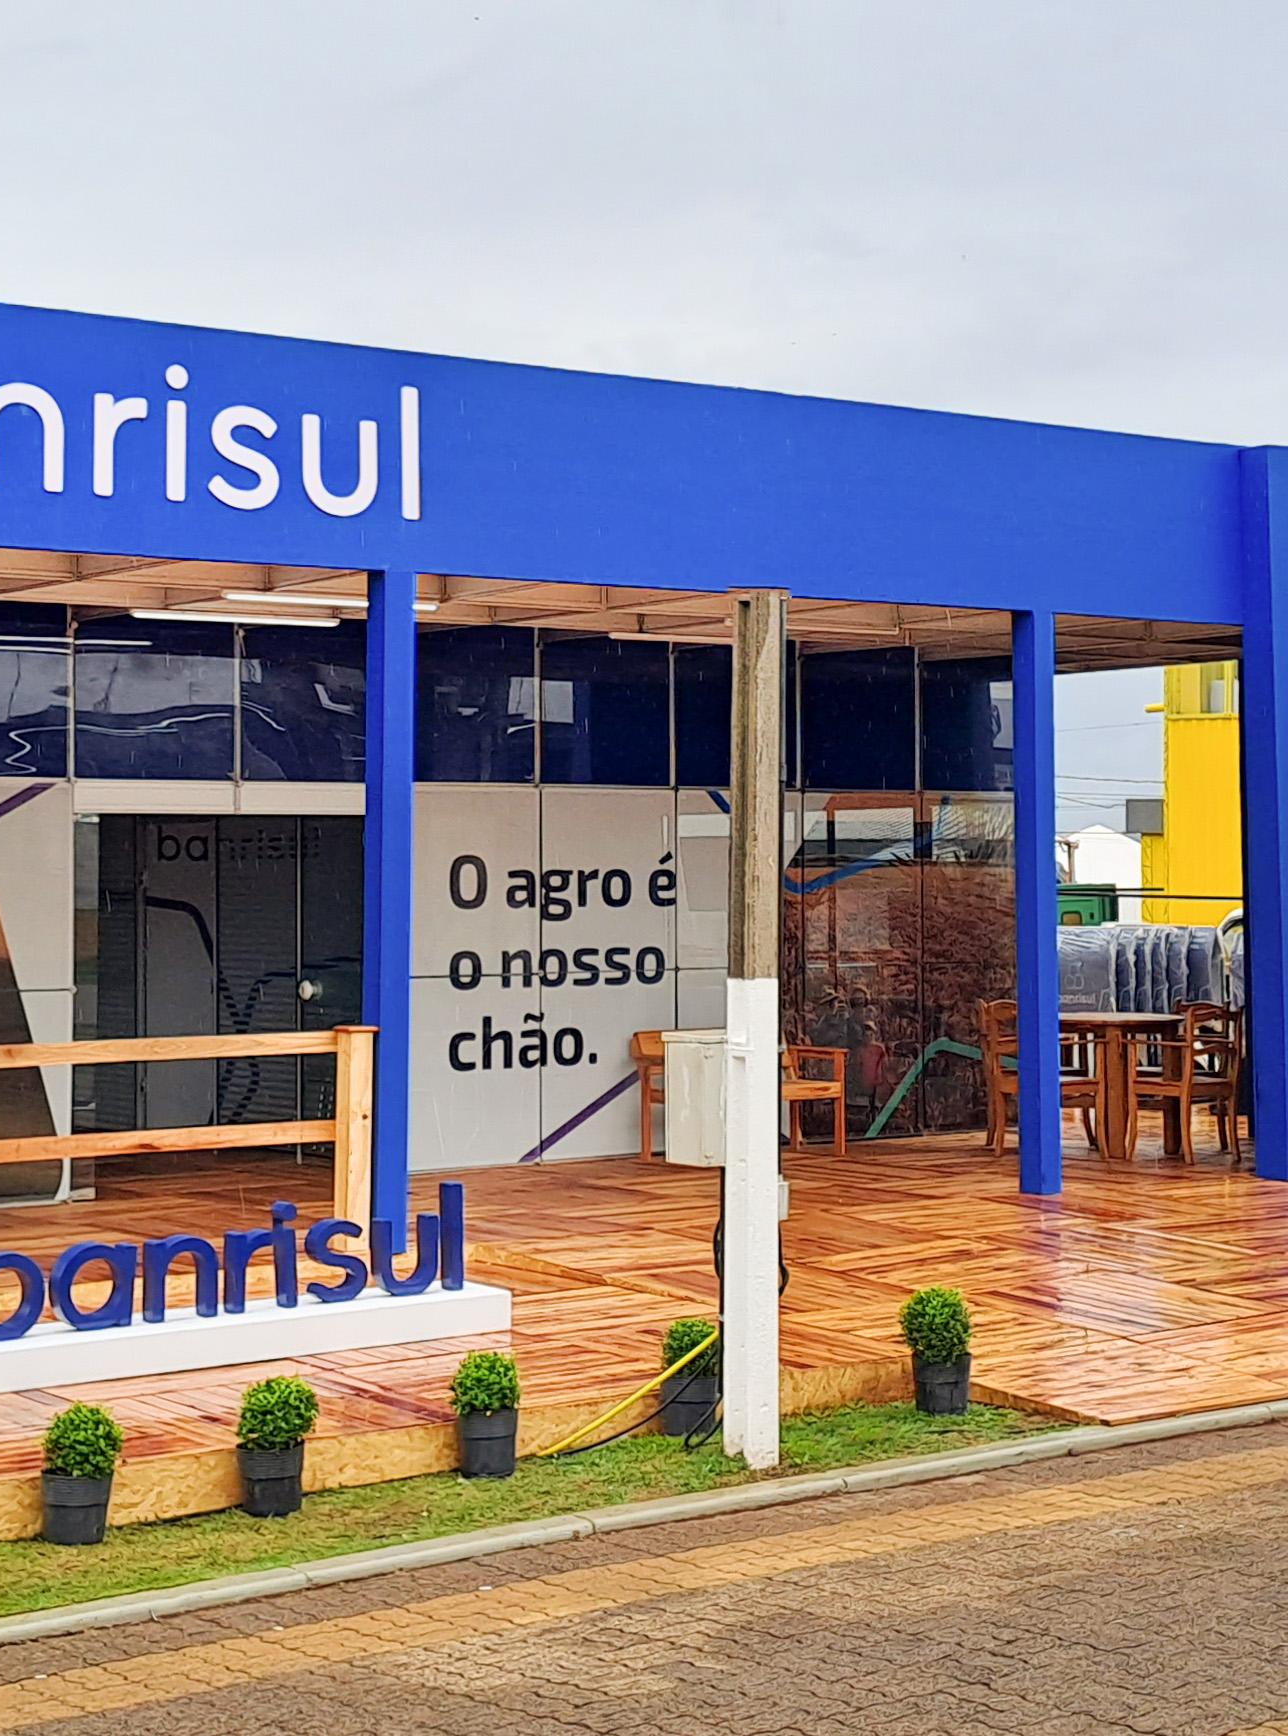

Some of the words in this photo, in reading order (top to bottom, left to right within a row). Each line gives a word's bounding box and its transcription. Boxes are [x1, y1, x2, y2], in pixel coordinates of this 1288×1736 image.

[449, 854, 488, 910] O
[506, 868, 633, 922] agro
[648, 851, 677, 907] é
[449, 950, 482, 991] o
[501, 946, 666, 989] nosso
[449, 1012, 598, 1072] chão.
